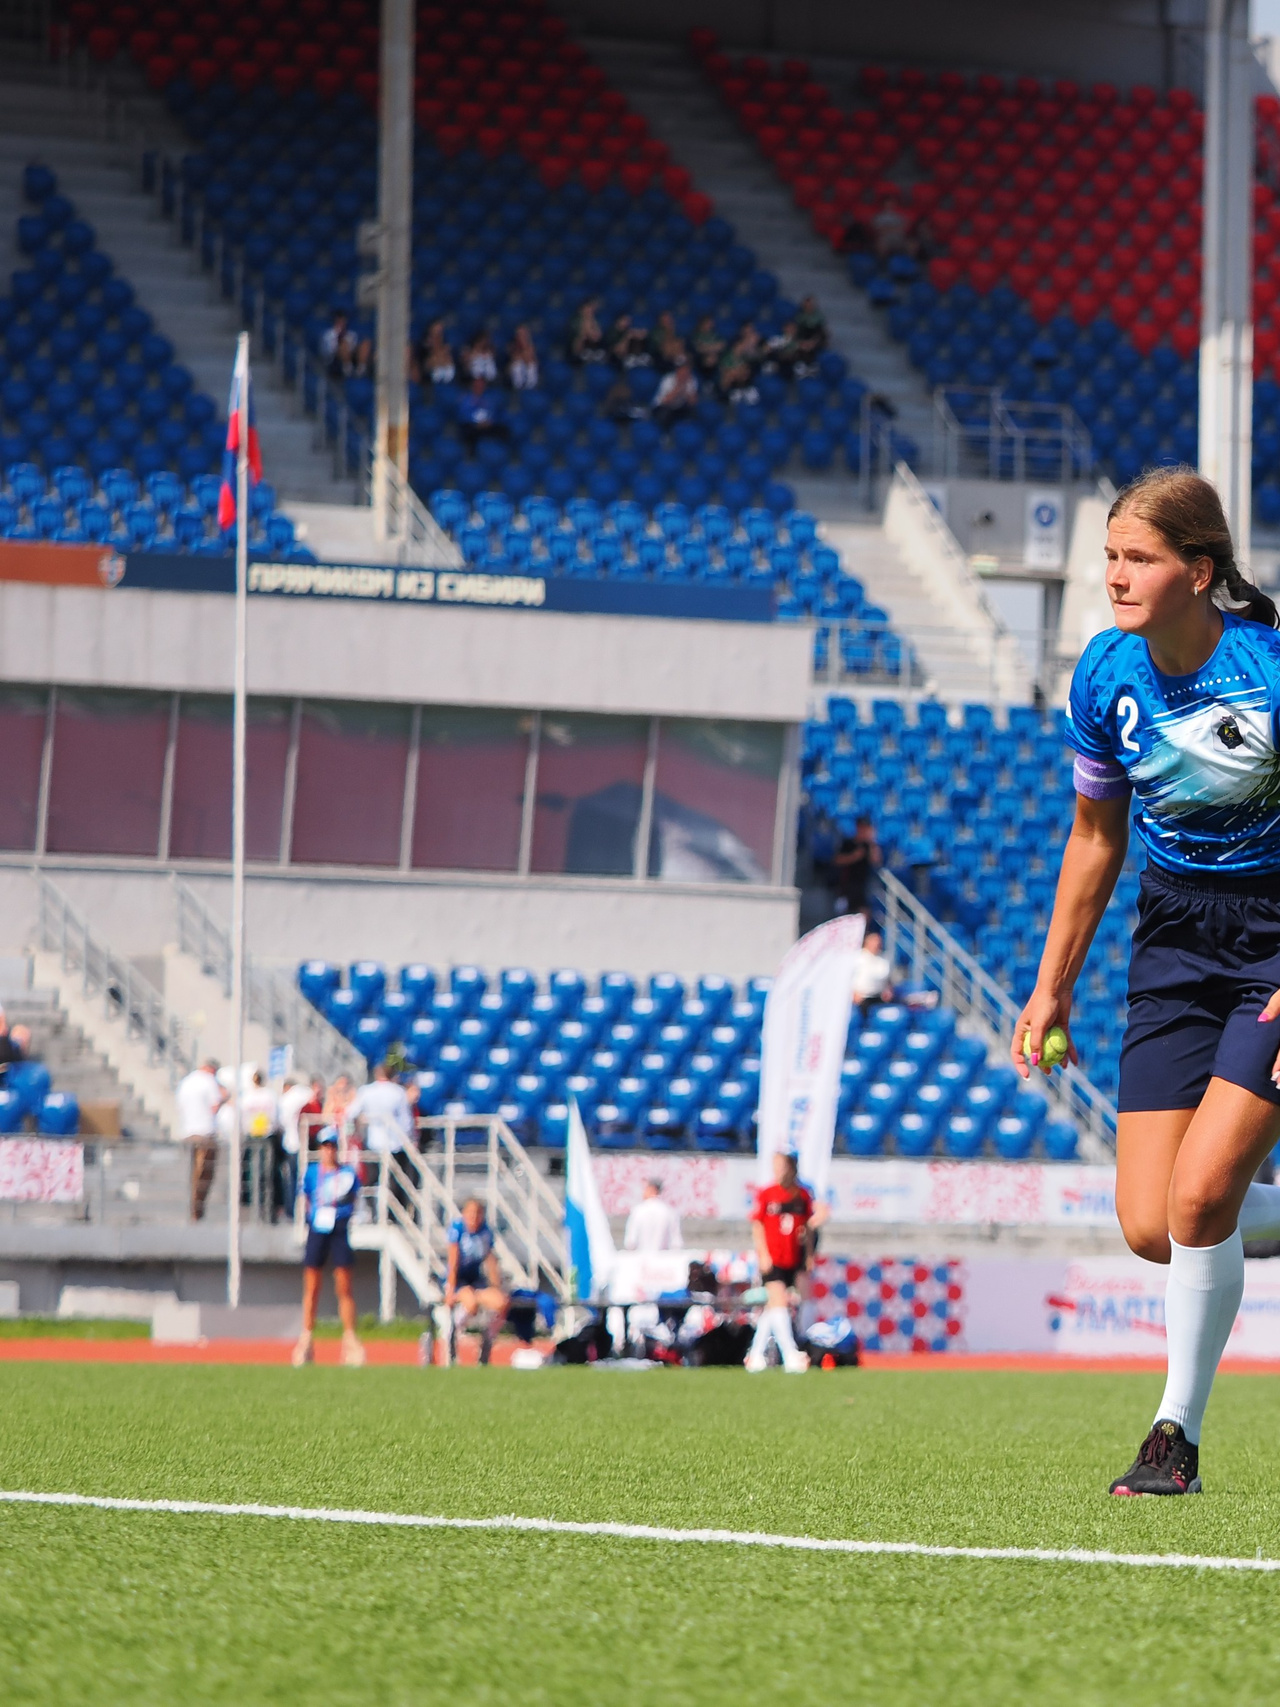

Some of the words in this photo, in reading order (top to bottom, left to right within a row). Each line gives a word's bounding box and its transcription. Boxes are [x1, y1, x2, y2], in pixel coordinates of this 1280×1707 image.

[249, 562, 395, 599] ПРЯМИКОМ
[396, 569, 435, 600] ИЗ
[436, 571, 546, 607] СИБИРИ
[1117, 695, 1140, 753] 2
